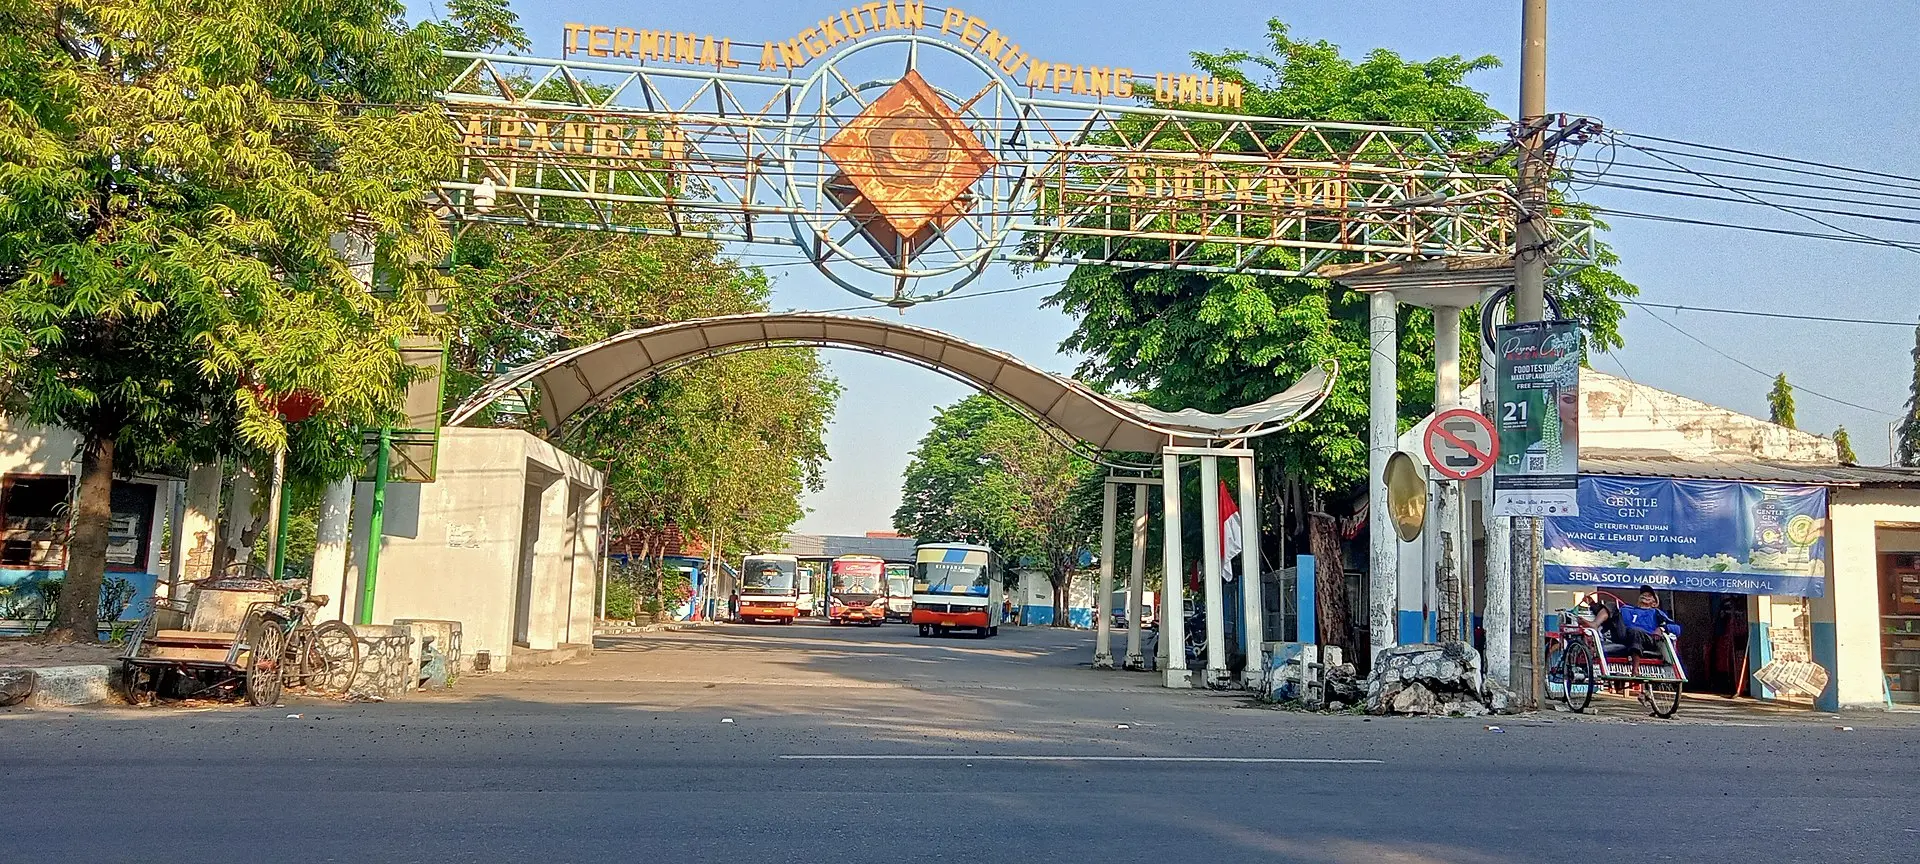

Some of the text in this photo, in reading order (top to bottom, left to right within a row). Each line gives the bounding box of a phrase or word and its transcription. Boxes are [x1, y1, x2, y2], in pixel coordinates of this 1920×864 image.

[564, 0, 1243, 108] TERMINAL ANGKUTAN PENUMPANG UMUM
[1503, 401, 1527, 421] 21
[1606, 497, 1658, 508] GENTLE
[1594, 522, 1669, 531] DETERJEN TUMBUHAN
[1566, 531, 1697, 544] WANGI & LEMBUT DI TANGAN
[1568, 571, 1599, 582] SEDIA
[1601, 573, 1631, 583] SOTO
[1633, 574, 1678, 585] MADURA
[1685, 576, 1718, 588] POJOK
[1720, 578, 1774, 590] TERMINAL
